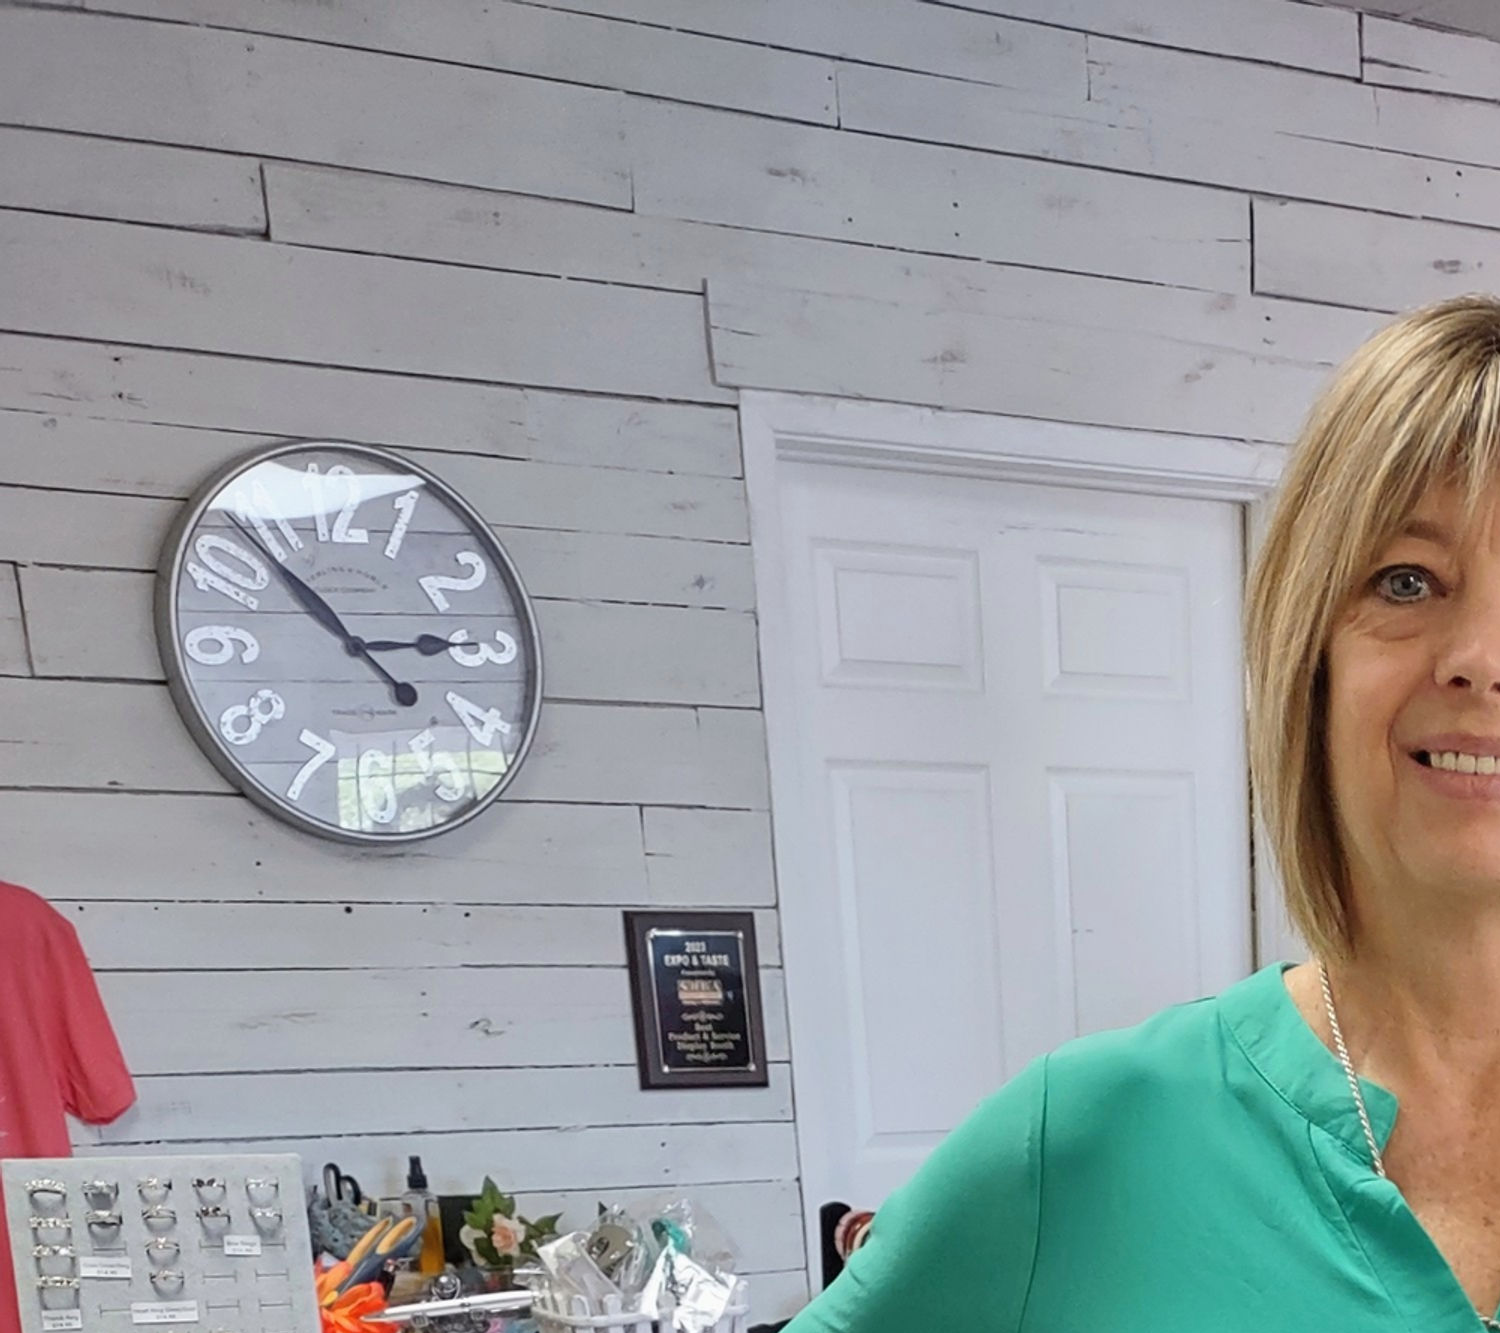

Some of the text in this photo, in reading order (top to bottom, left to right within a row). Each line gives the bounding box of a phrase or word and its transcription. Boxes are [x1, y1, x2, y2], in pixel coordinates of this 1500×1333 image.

[235, 480, 304, 562] 11
[302, 463, 369, 543] 12
[384, 490, 419, 559] 1
[186, 534, 269, 610] 10
[418, 551, 486, 612] 2
[185, 625, 260, 666] 9
[448, 629, 517, 667] 3
[219, 689, 285, 745] 8
[446, 691, 511, 746] 4
[287, 728, 336, 800] 7
[359, 749, 397, 824] 6
[408, 728, 465, 802] 5
[700, 954, 730, 967] TASTE
